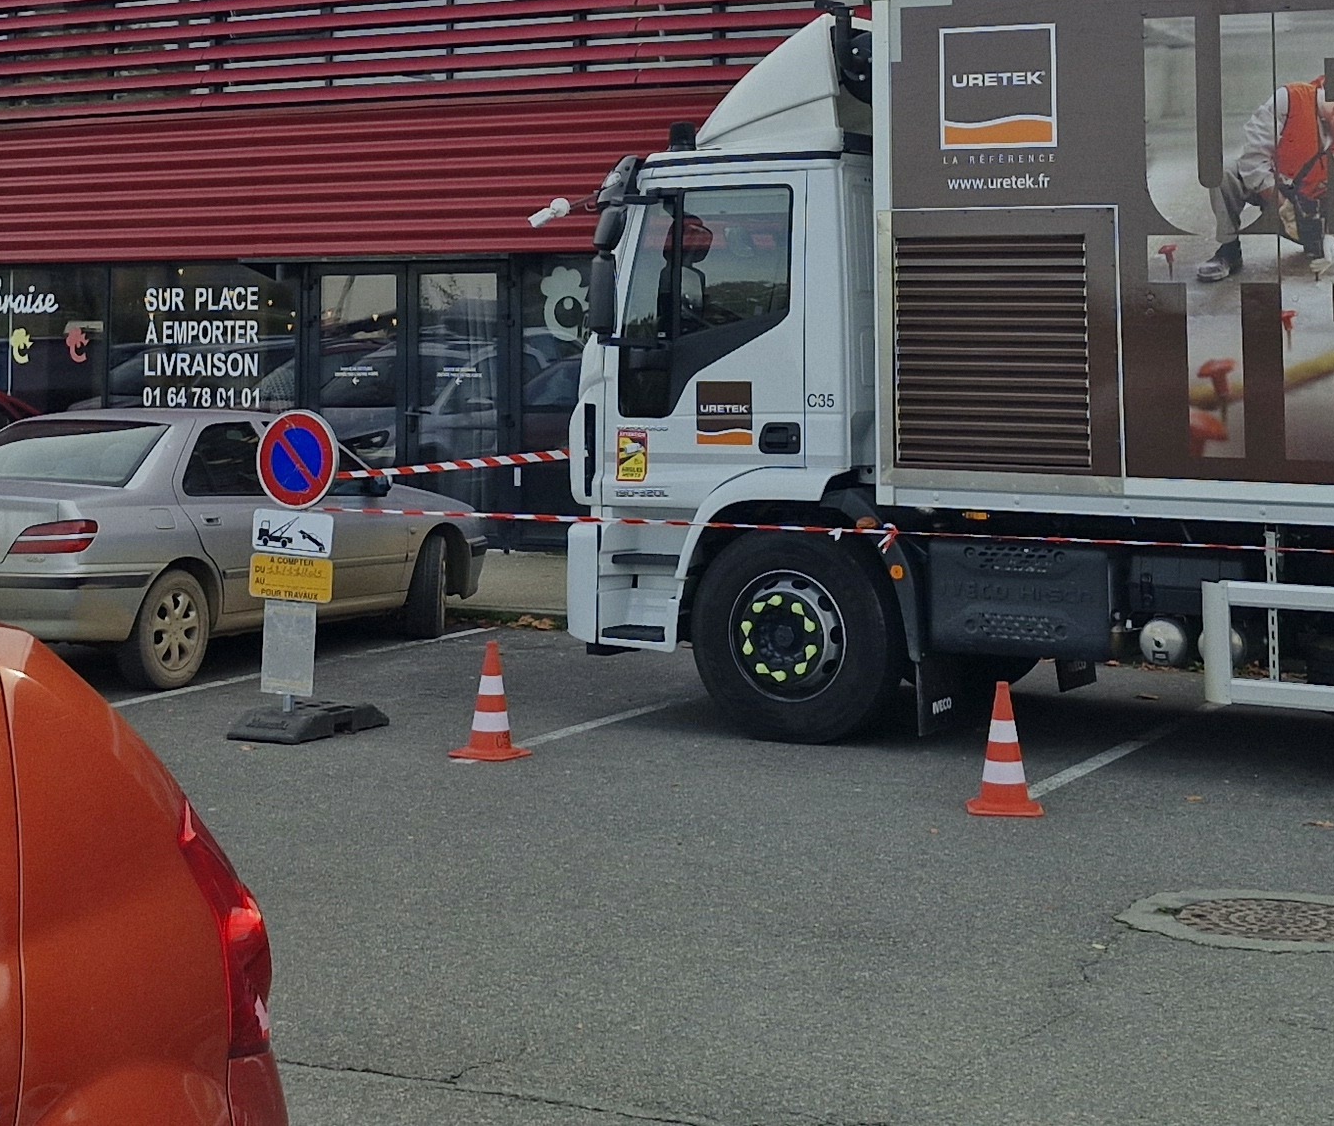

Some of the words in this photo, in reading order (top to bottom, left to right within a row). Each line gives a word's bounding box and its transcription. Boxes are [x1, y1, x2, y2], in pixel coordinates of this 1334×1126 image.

[943, 155, 958, 165] LA
[969, 153, 1056, 165] RÉFÉRENCE
[948, 173, 1051, 190] www.uretek.fr
[145, 287, 185, 312] SUR
[195, 287, 259, 311] PLACE
[162, 320, 259, 344] EMPORTER
[143, 353, 259, 376] LIVRAISON
[143, 386, 161, 407] 01
[167, 386, 187, 407] 64
[191, 387, 211, 407] 78
[216, 388, 235, 408] 01
[241, 388, 260, 408] 01
[807, 393, 835, 408] C35
[255, 565, 265, 573] DU
[277, 556, 314, 566] COMPTER
[254, 577, 265, 585] AU
[261, 589, 282, 597] POUR
[284, 591, 318, 600] TRAVAUX
[932, 696, 953, 715] IVECO
